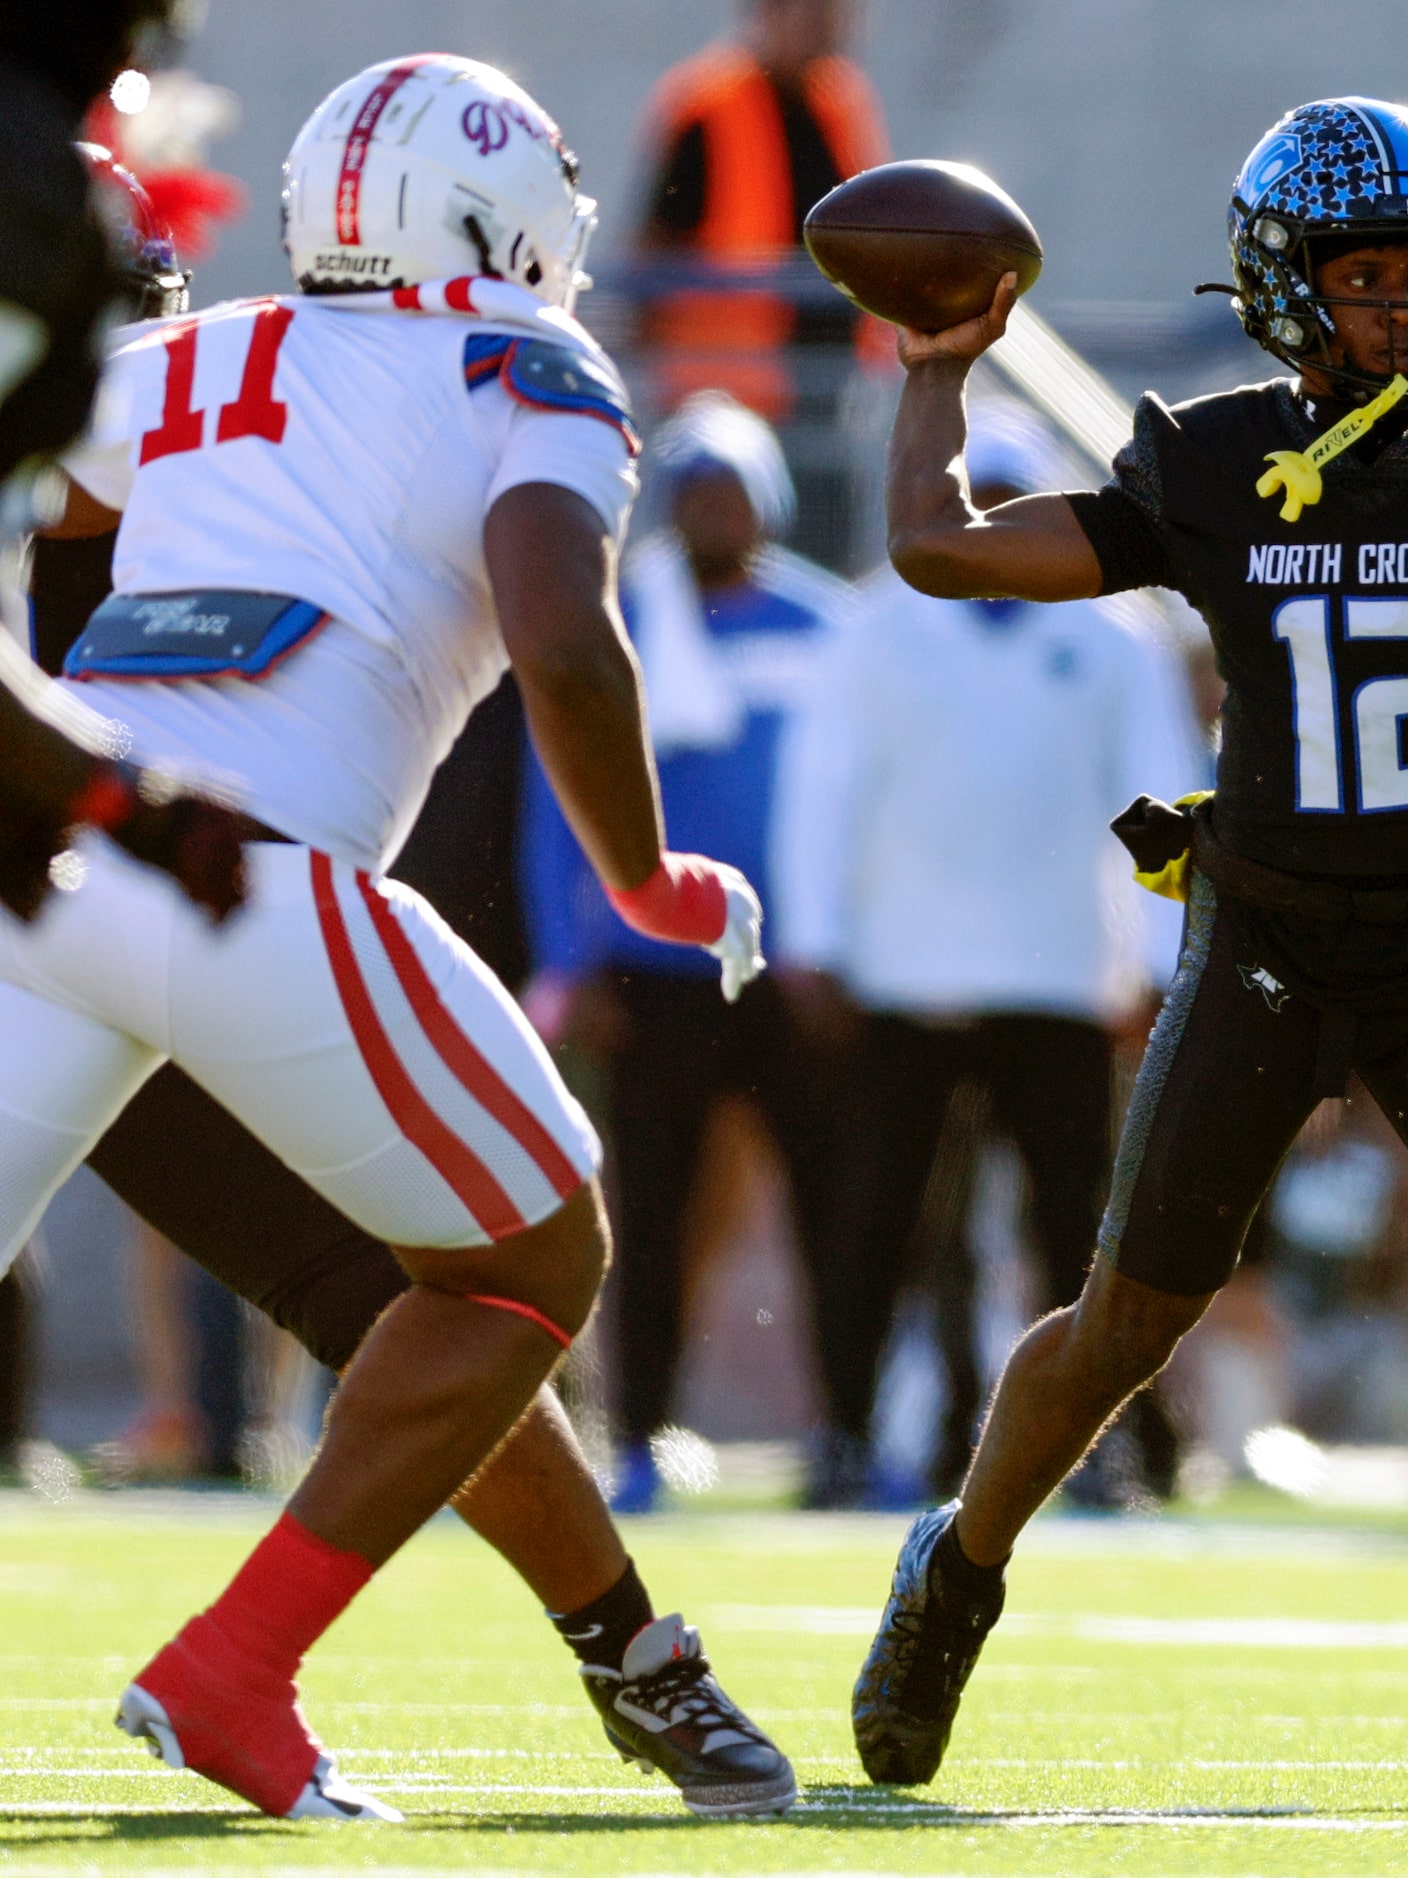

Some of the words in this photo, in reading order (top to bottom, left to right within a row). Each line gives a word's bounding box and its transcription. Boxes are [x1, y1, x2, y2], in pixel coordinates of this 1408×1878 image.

[315, 251, 391, 275] schutt
[139, 296, 296, 467] 11
[1246, 544, 1342, 584] NORTH
